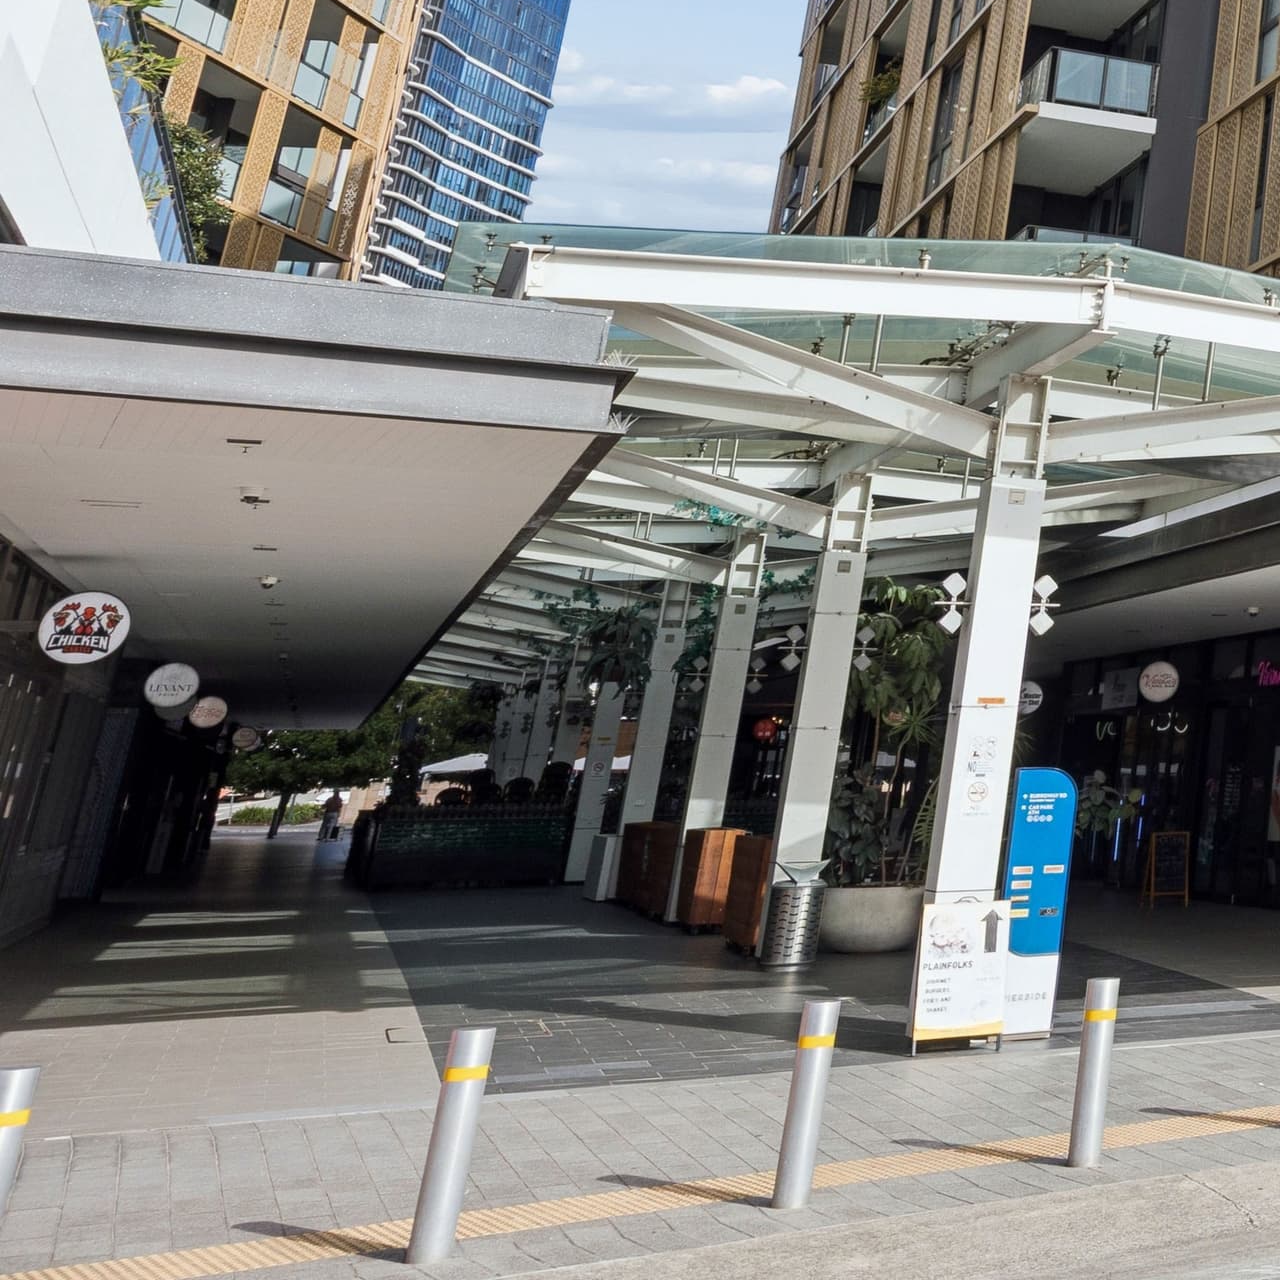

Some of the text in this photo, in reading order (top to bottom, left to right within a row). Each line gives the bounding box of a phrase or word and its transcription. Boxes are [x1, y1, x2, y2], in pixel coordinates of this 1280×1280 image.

[47, 634, 109, 650] CHICKEN
[149, 684, 194, 693] LEVANT
[922, 960, 975, 971] PLAINFOLKS
